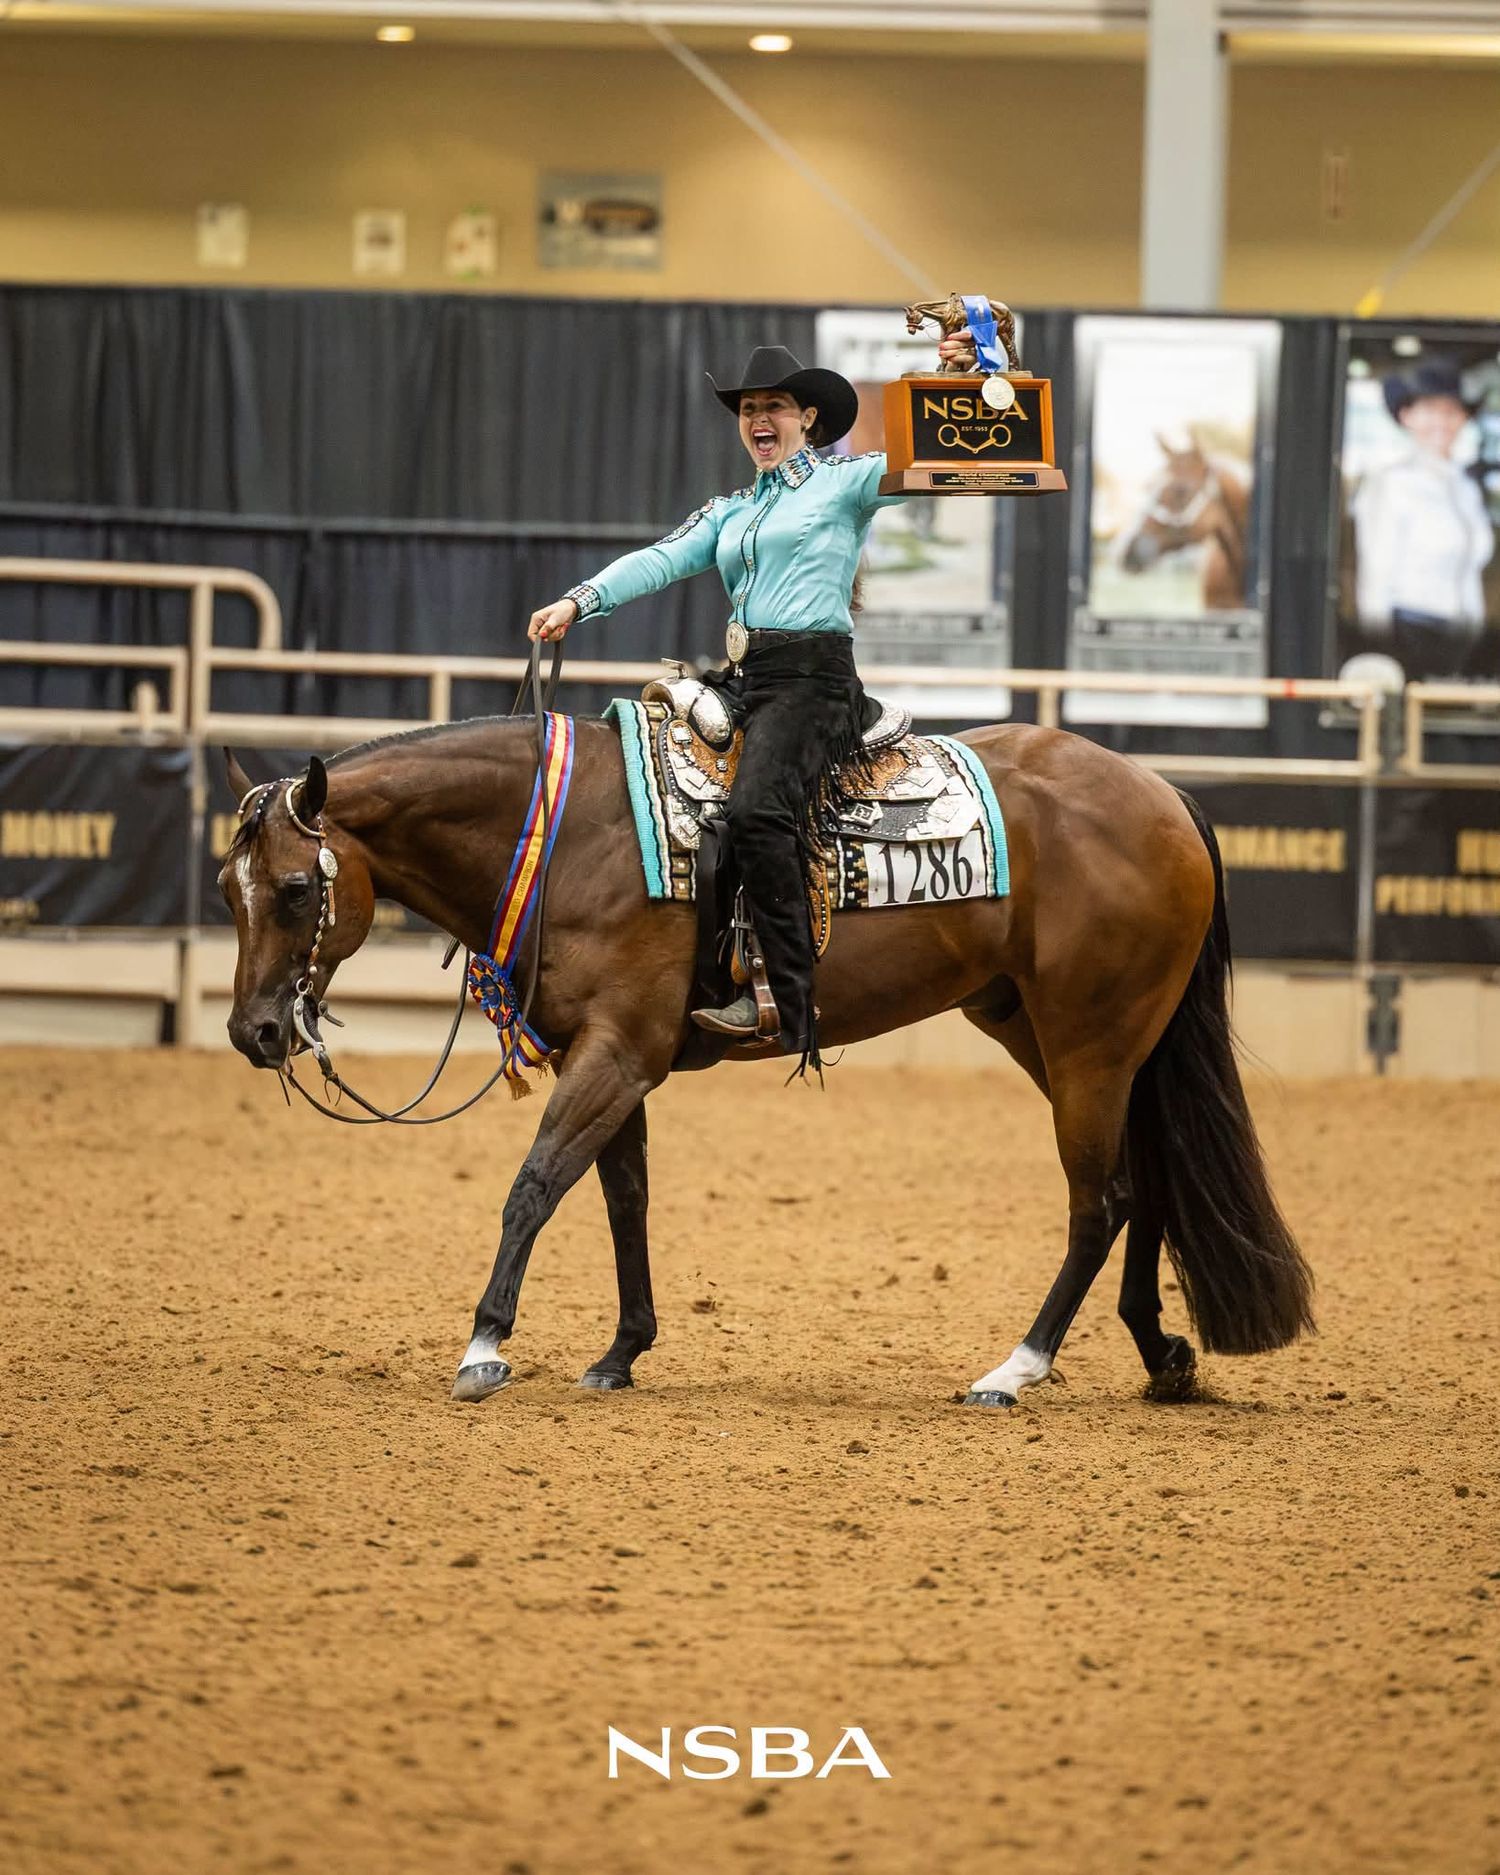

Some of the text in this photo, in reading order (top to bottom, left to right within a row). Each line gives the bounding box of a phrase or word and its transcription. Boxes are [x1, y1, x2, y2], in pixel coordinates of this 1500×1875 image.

[923, 397, 1029, 421] NSBA
[2, 810, 116, 858] MONEY
[878, 840, 974, 905] 1286
